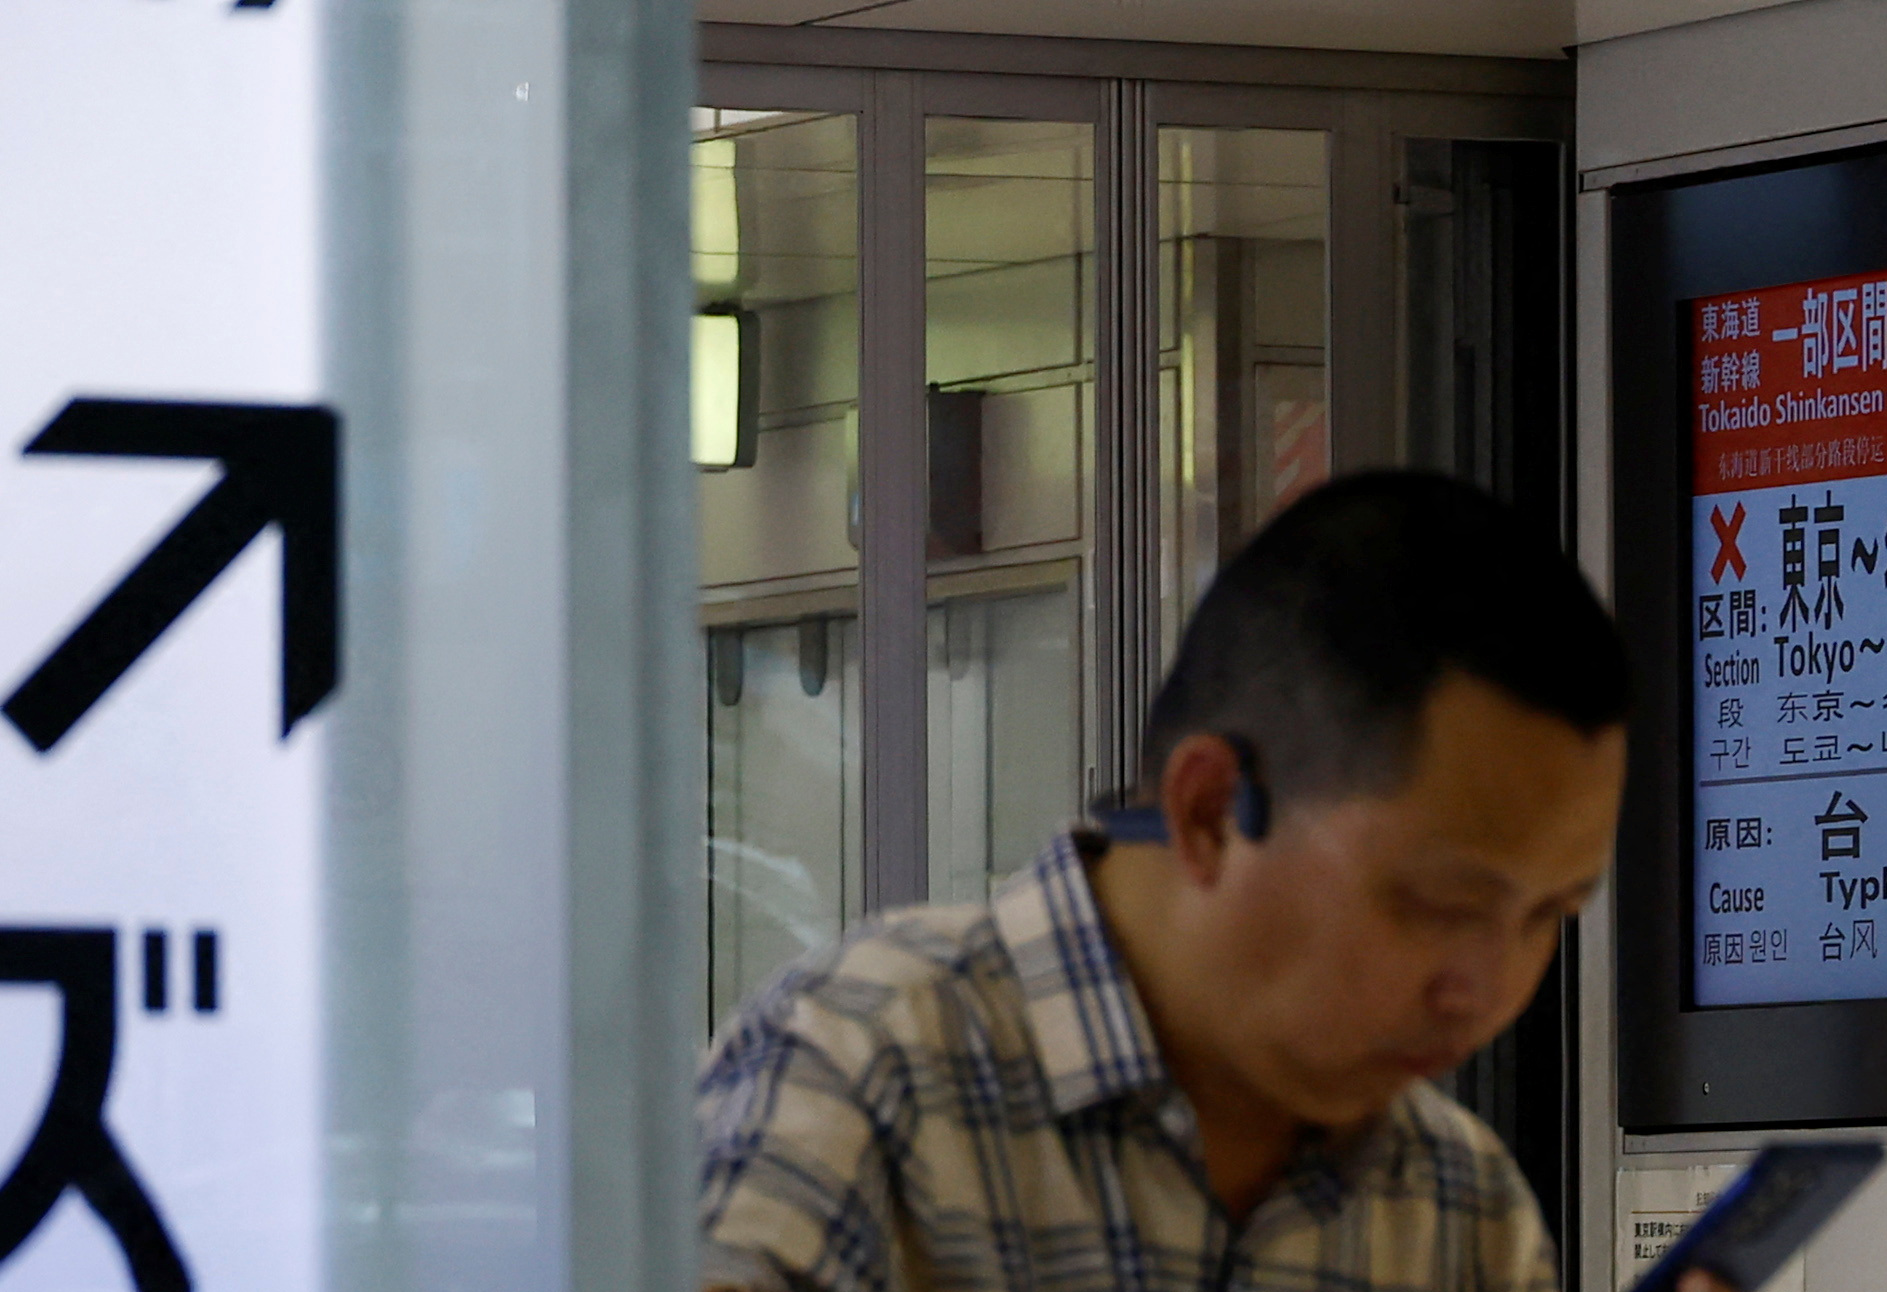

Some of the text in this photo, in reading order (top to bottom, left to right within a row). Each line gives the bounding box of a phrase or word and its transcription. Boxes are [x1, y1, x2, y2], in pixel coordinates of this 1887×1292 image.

[1701, 296, 1761, 343] 東海道
[1701, 349, 1761, 394] 新幹線
[1699, 392, 1771, 434] Tokaido
[1775, 387, 1883, 425] Shinkansen
[1704, 650, 1760, 689] Section
[1717, 697, 1745, 730] 段
[1710, 736, 1752, 772] 구간
[1709, 881, 1764, 914] Cause
[1703, 928, 1787, 967] 原因 원인
[1819, 919, 1878, 963] 台风
